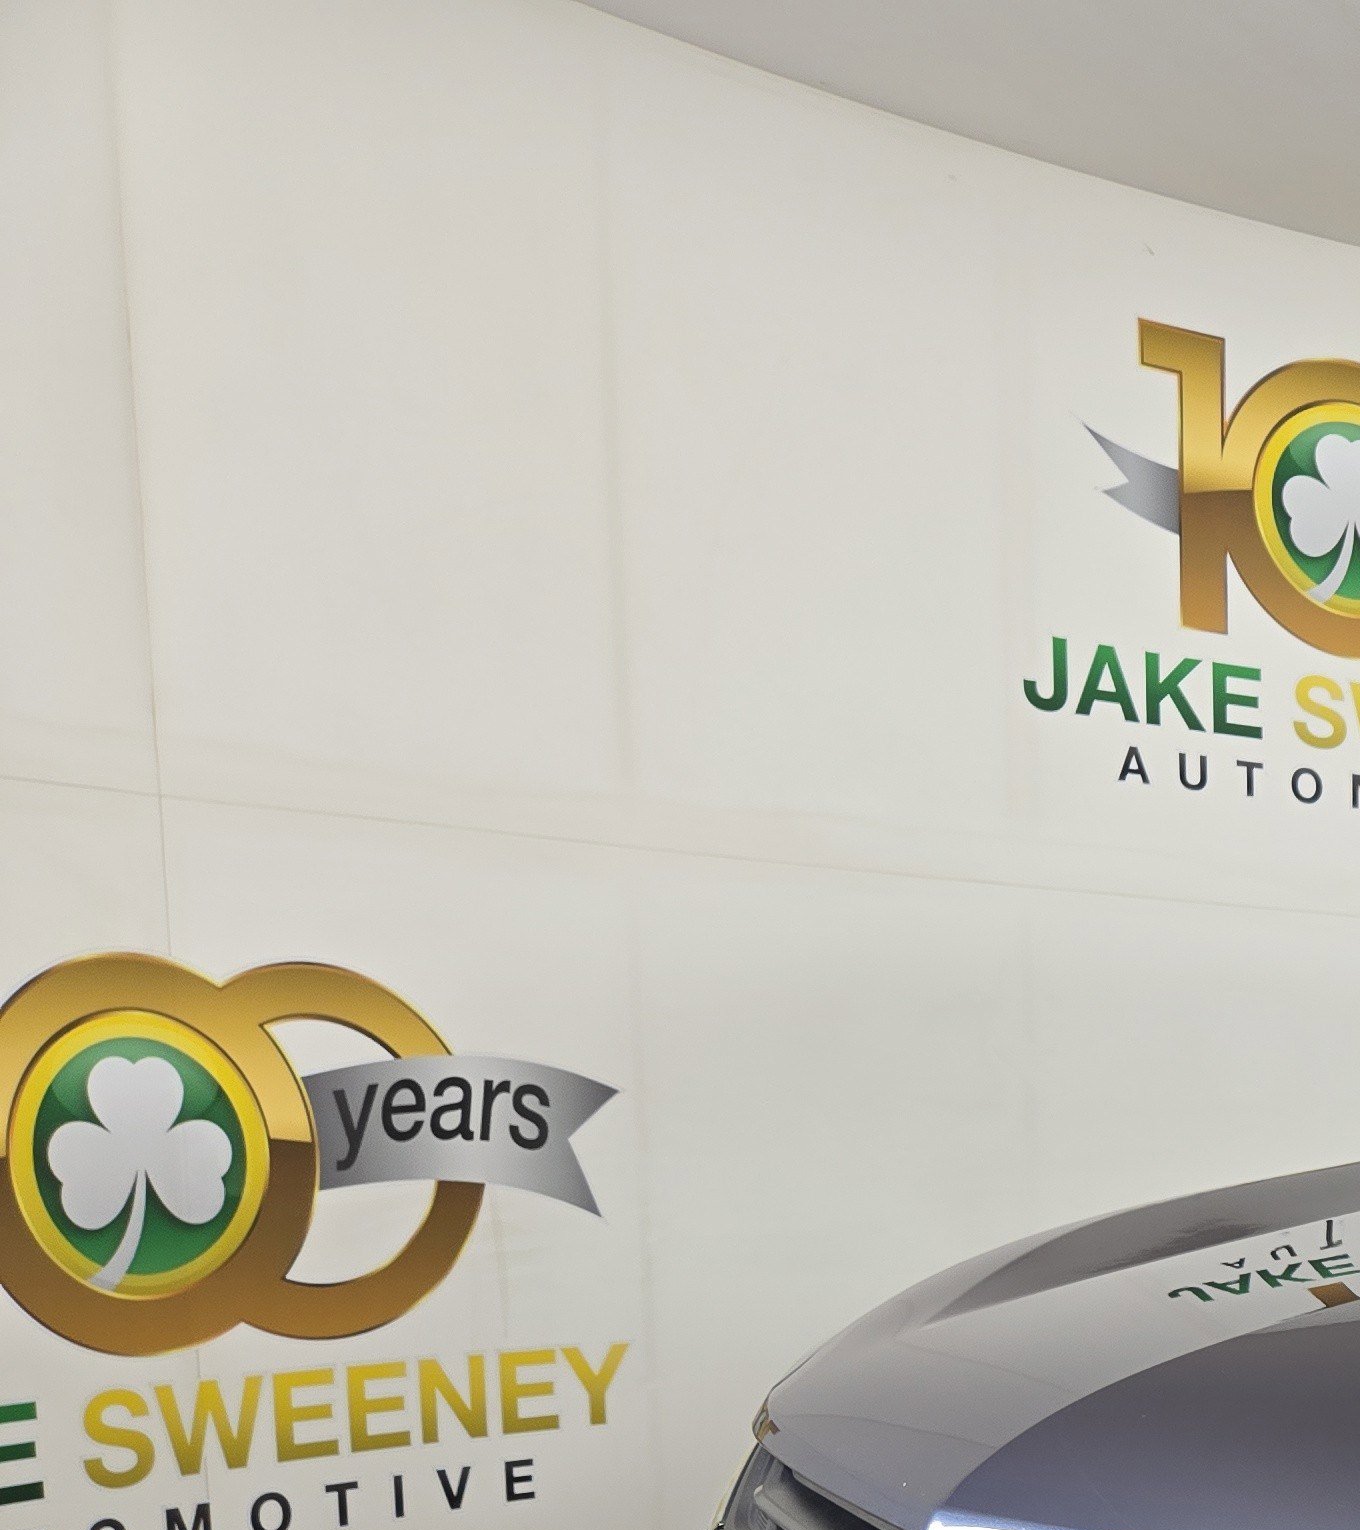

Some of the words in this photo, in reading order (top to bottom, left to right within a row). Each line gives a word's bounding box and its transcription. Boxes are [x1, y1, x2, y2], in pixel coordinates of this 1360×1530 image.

[1023, 636, 1264, 740] JAKE
[333, 1075, 551, 1171] years
[82, 1343, 630, 1490] SWEENEY
